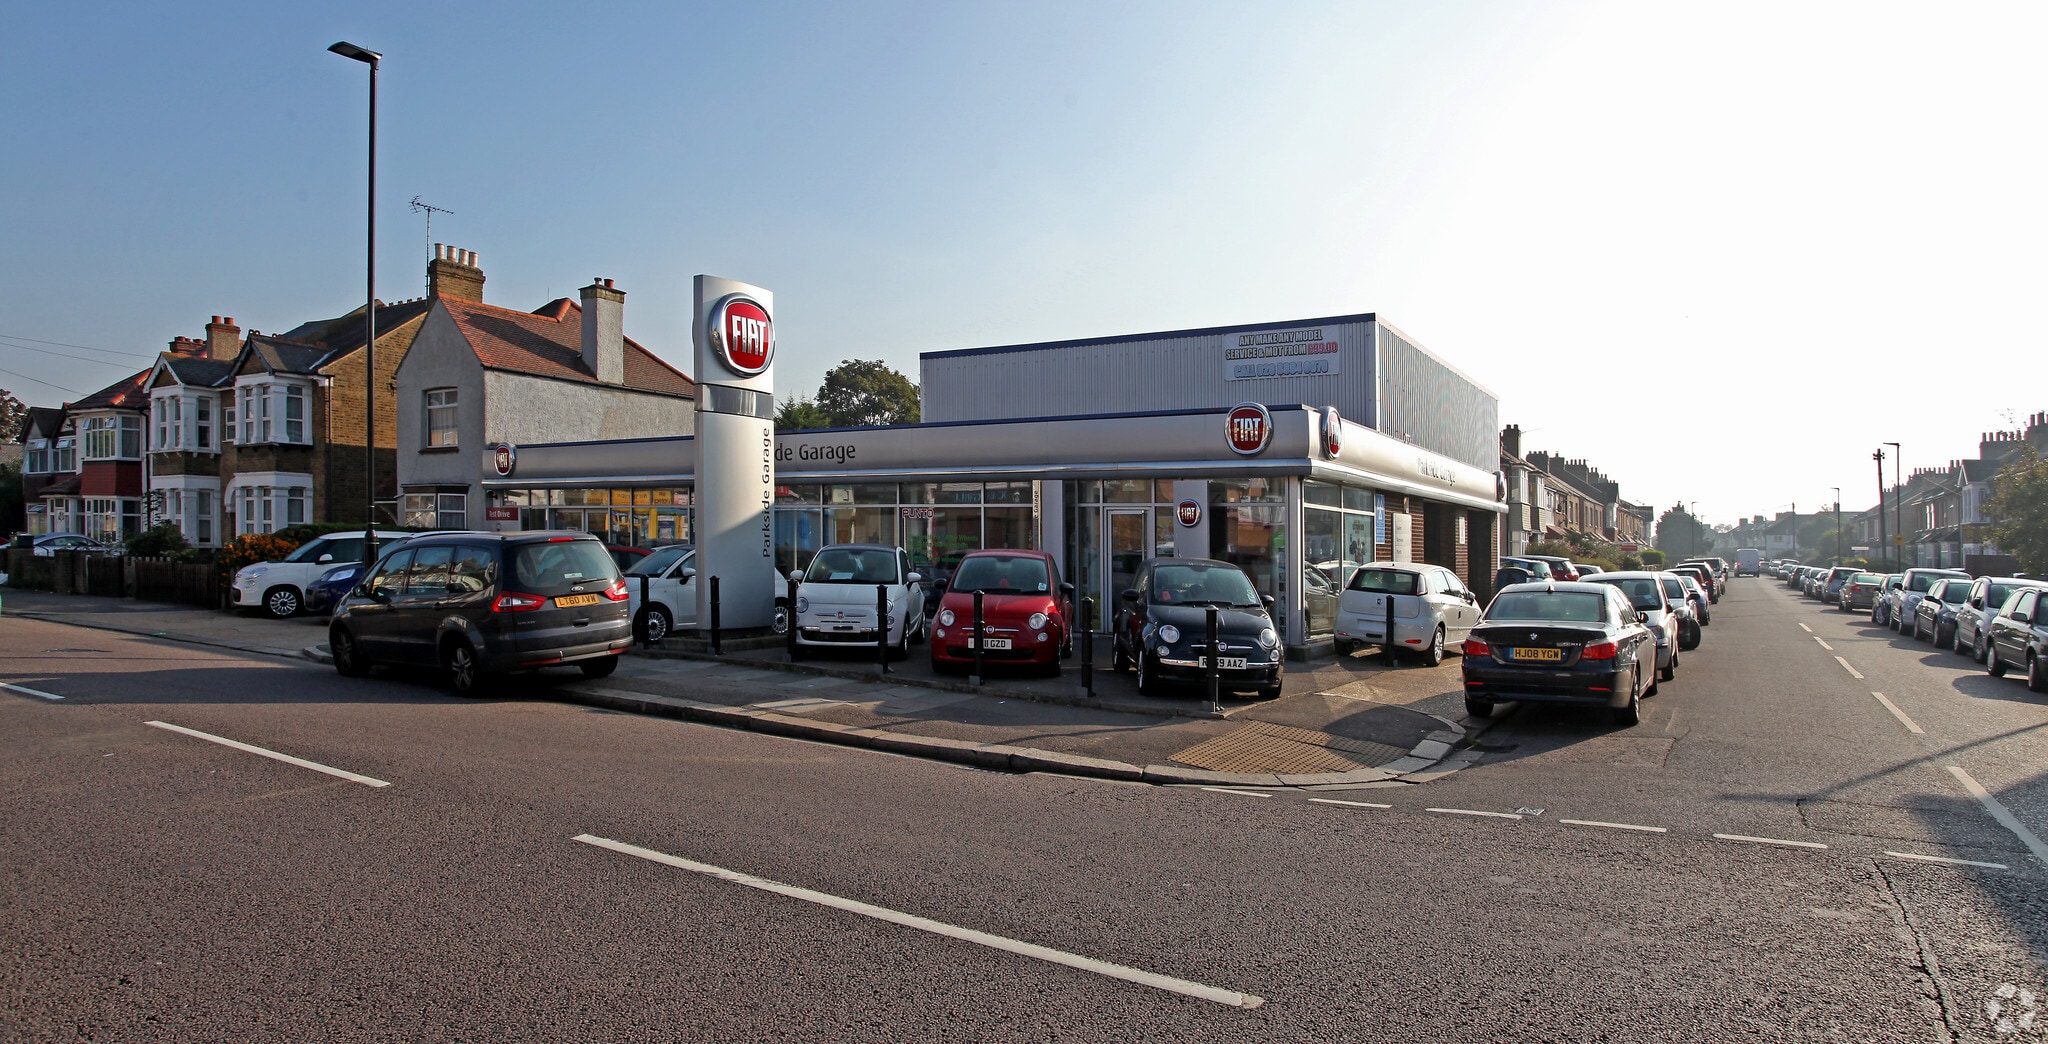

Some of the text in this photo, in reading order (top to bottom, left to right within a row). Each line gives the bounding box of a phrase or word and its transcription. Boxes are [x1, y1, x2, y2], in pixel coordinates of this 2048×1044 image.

[731, 314, 767, 357] FIAT
[1239, 329, 1323, 347] ANY MAKE ANY MODEL
[1226, 348, 1257, 360] SERVICE
[1257, 347, 1265, 358] &
[1265, 345, 1284, 358] MOT
[1284, 343, 1307, 356] FROM
[1234, 363, 1256, 378] CALL
[1233, 417, 1261, 442] FIAT
[799, 444, 856, 464] Garage
[761, 427, 772, 558] Parkside Garage
[902, 507, 935, 519] PUNTO
[1181, 507, 1196, 519] FIAT
[1515, 649, 1539, 658] HJ08
[1227, 659, 1244, 669] AAZ
